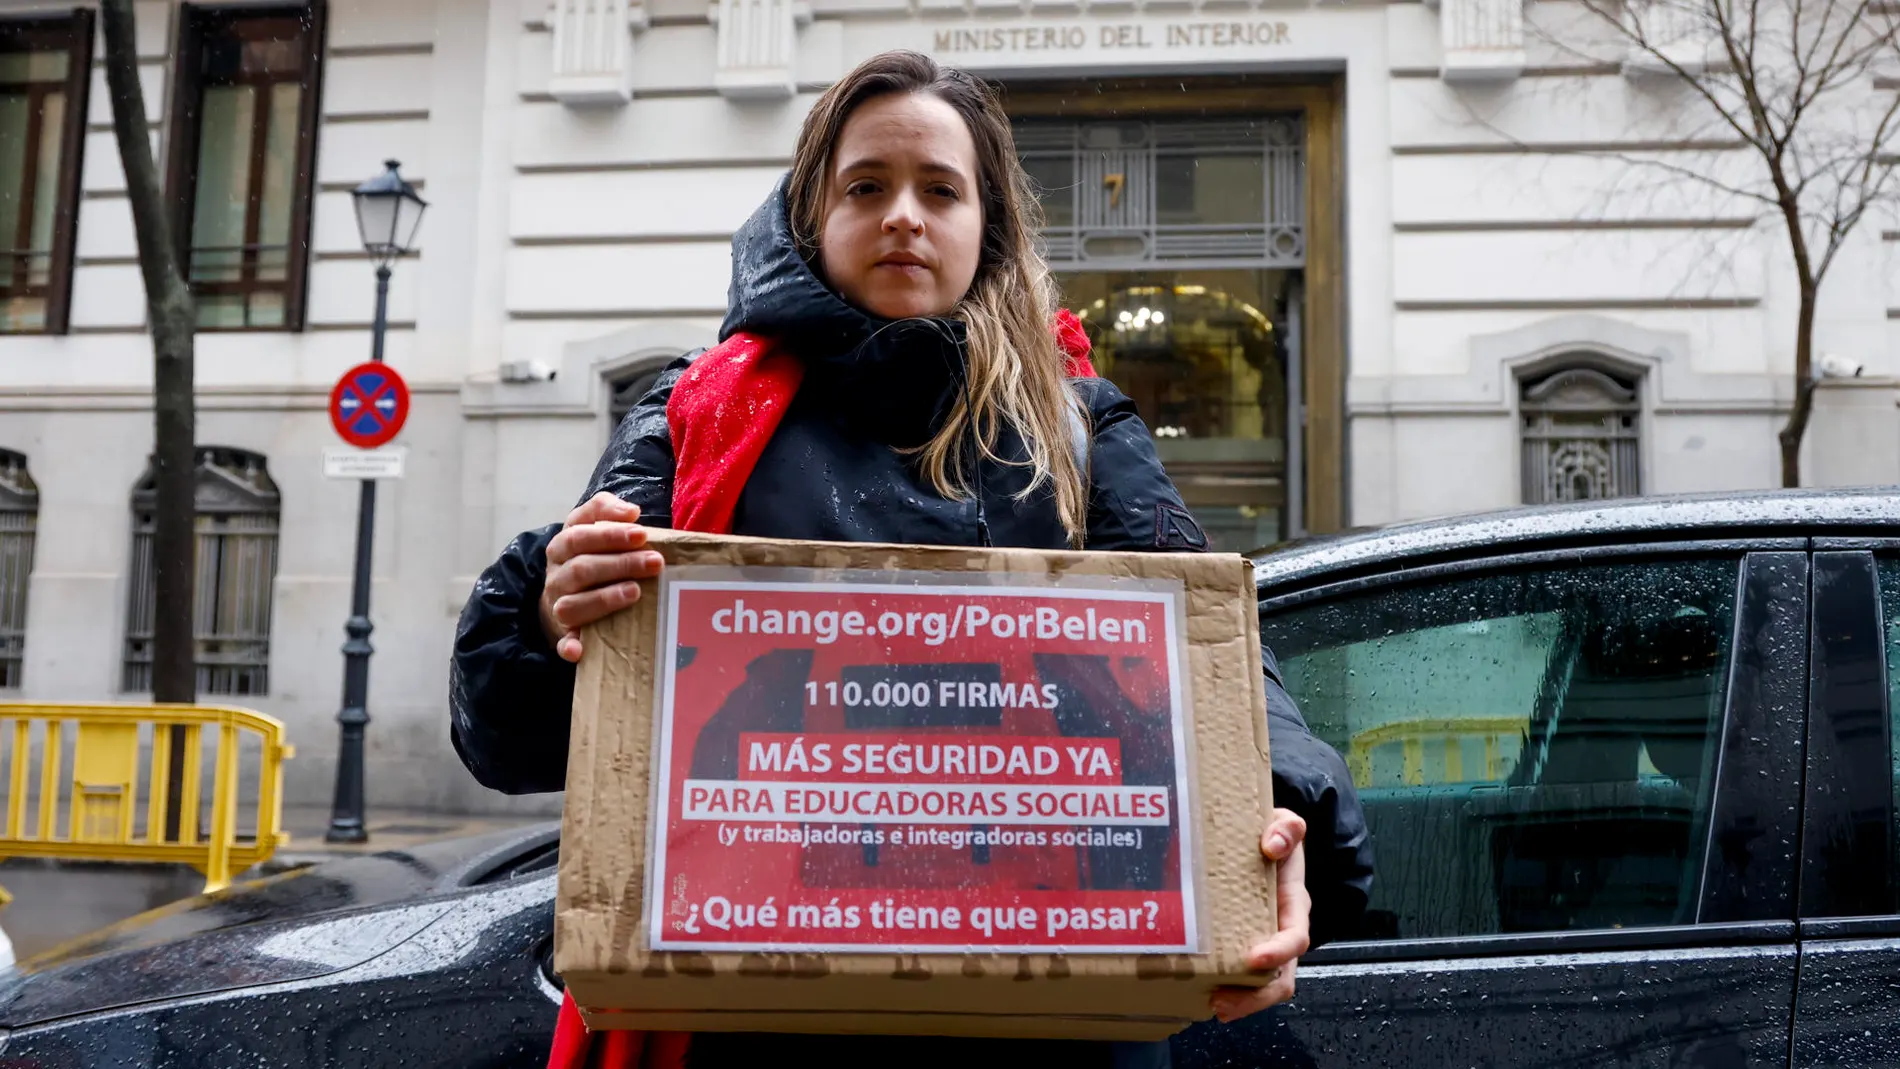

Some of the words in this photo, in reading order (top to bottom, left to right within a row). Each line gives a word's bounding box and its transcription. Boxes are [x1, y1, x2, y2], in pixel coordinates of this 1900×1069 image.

[934, 27, 1086, 52] MINISTERIO
[1100, 25, 1152, 48] DEL
[1166, 22, 1292, 47] INTERIOR
[1104, 174, 1123, 208] 7
[712, 599, 1146, 646] change.org/PorBelen
[805, 681, 930, 707] 110.000
[939, 682, 1059, 709] FIRMAS
[749, 737, 832, 773] MÁS
[842, 743, 1059, 775] SEGURIDAD
[1066, 746, 1114, 776] YA
[689, 788, 774, 813] PARA
[784, 789, 1008, 816] EDUCADORAS
[1017, 792, 1165, 818] SOCIALES
[718, 823, 739, 846] (y
[744, 823, 884, 848] trabajadoras
[890, 830, 903, 844] e
[909, 826, 1047, 849] integradoras
[1052, 828, 1142, 849] sociales)
[684, 896, 778, 934] ¿Qué
[788, 897, 861, 929] más
[869, 898, 961, 930] tiene
[970, 906, 1037, 937] que
[1046, 901, 1159, 937] pasar?
